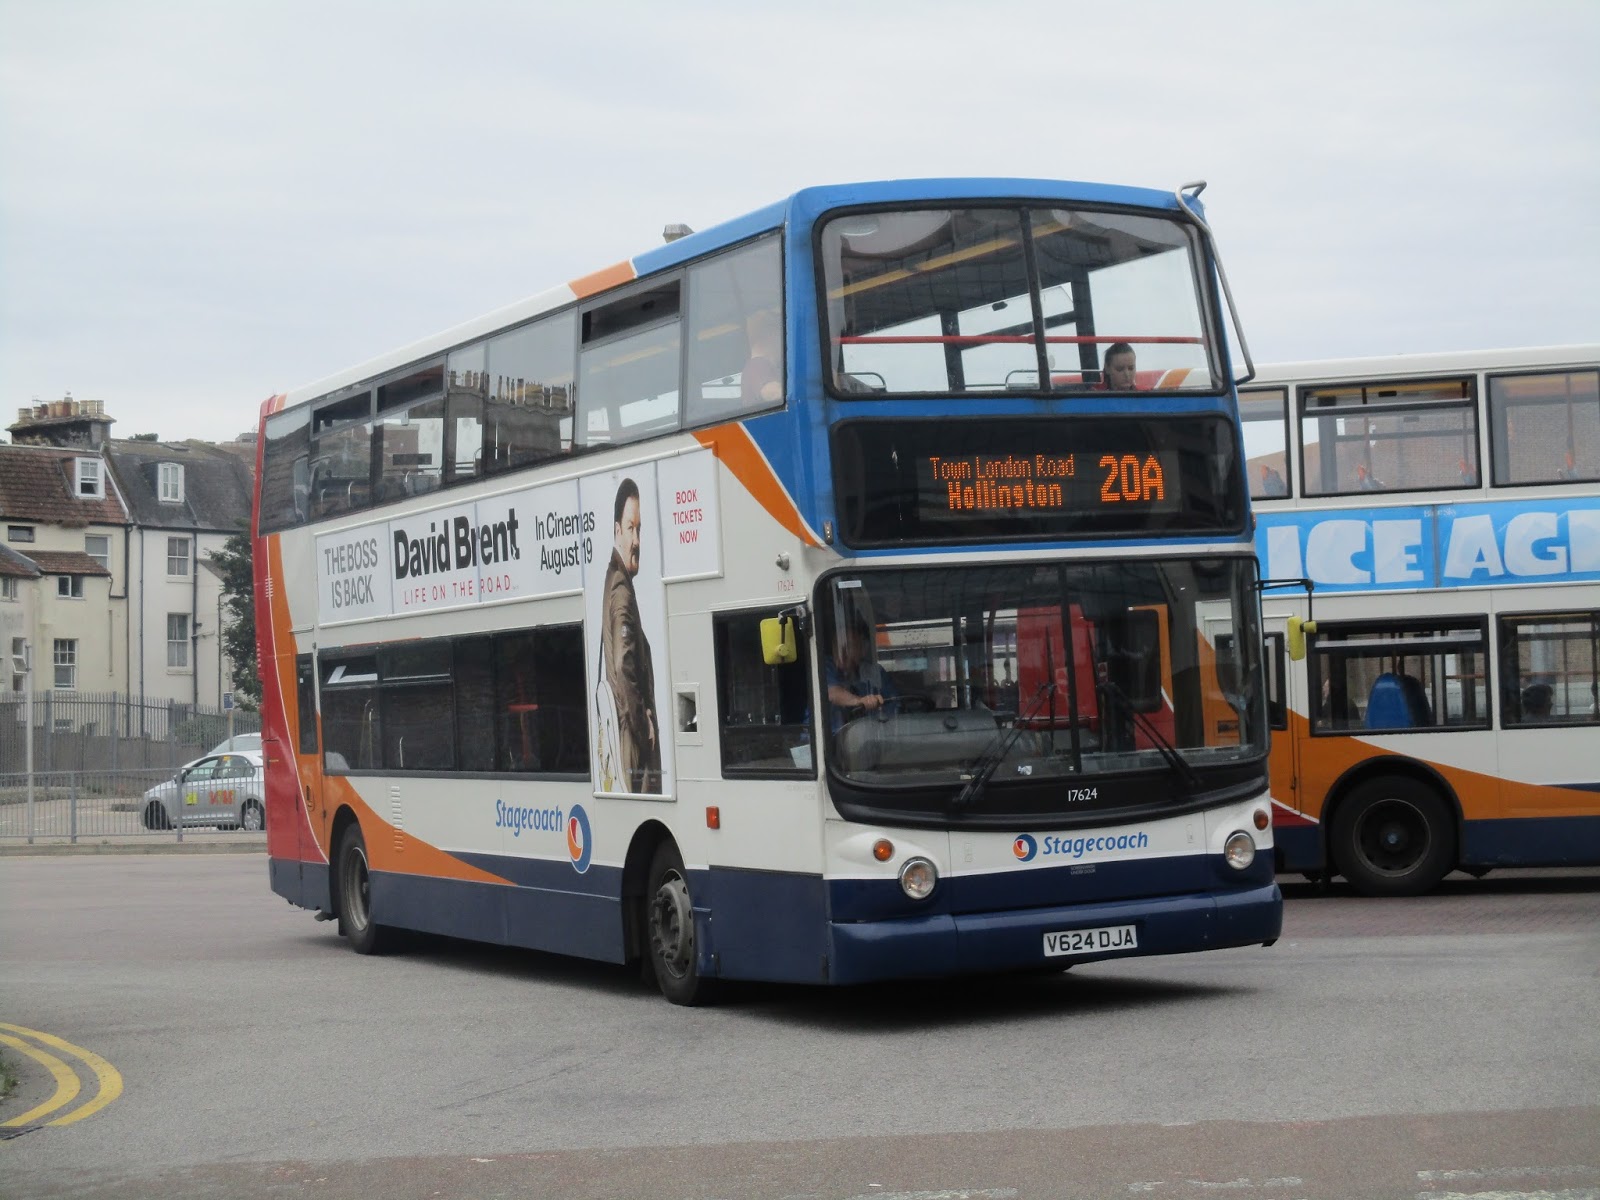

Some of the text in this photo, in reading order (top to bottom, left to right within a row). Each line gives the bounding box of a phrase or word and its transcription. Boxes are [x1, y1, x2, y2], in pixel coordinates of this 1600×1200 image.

[929, 453, 1075, 480] Town London Road
[1099, 454, 1165, 502] 20A
[675, 489, 698, 505] BOOK
[947, 479, 1063, 509] Hollington
[535, 510, 595, 541] In Cinemas
[672, 508, 703, 526] TICKETS
[393, 507, 521, 580] David Brent
[679, 529, 698, 545] NOW
[324, 537, 378, 576] THE BOSS
[540, 537, 593, 575] August 19
[1267, 518, 1425, 587] ICE
[331, 574, 375, 609] IS BACK
[404, 574, 511, 605] LIFE ON THE ROAD
[777, 579, 795, 592] 17624
[1067, 787, 1098, 801] 17624
[495, 798, 563, 838] Stagecoach
[1042, 831, 1148, 859] Stagecoach
[1046, 928, 1134, 953] V624 DJA
